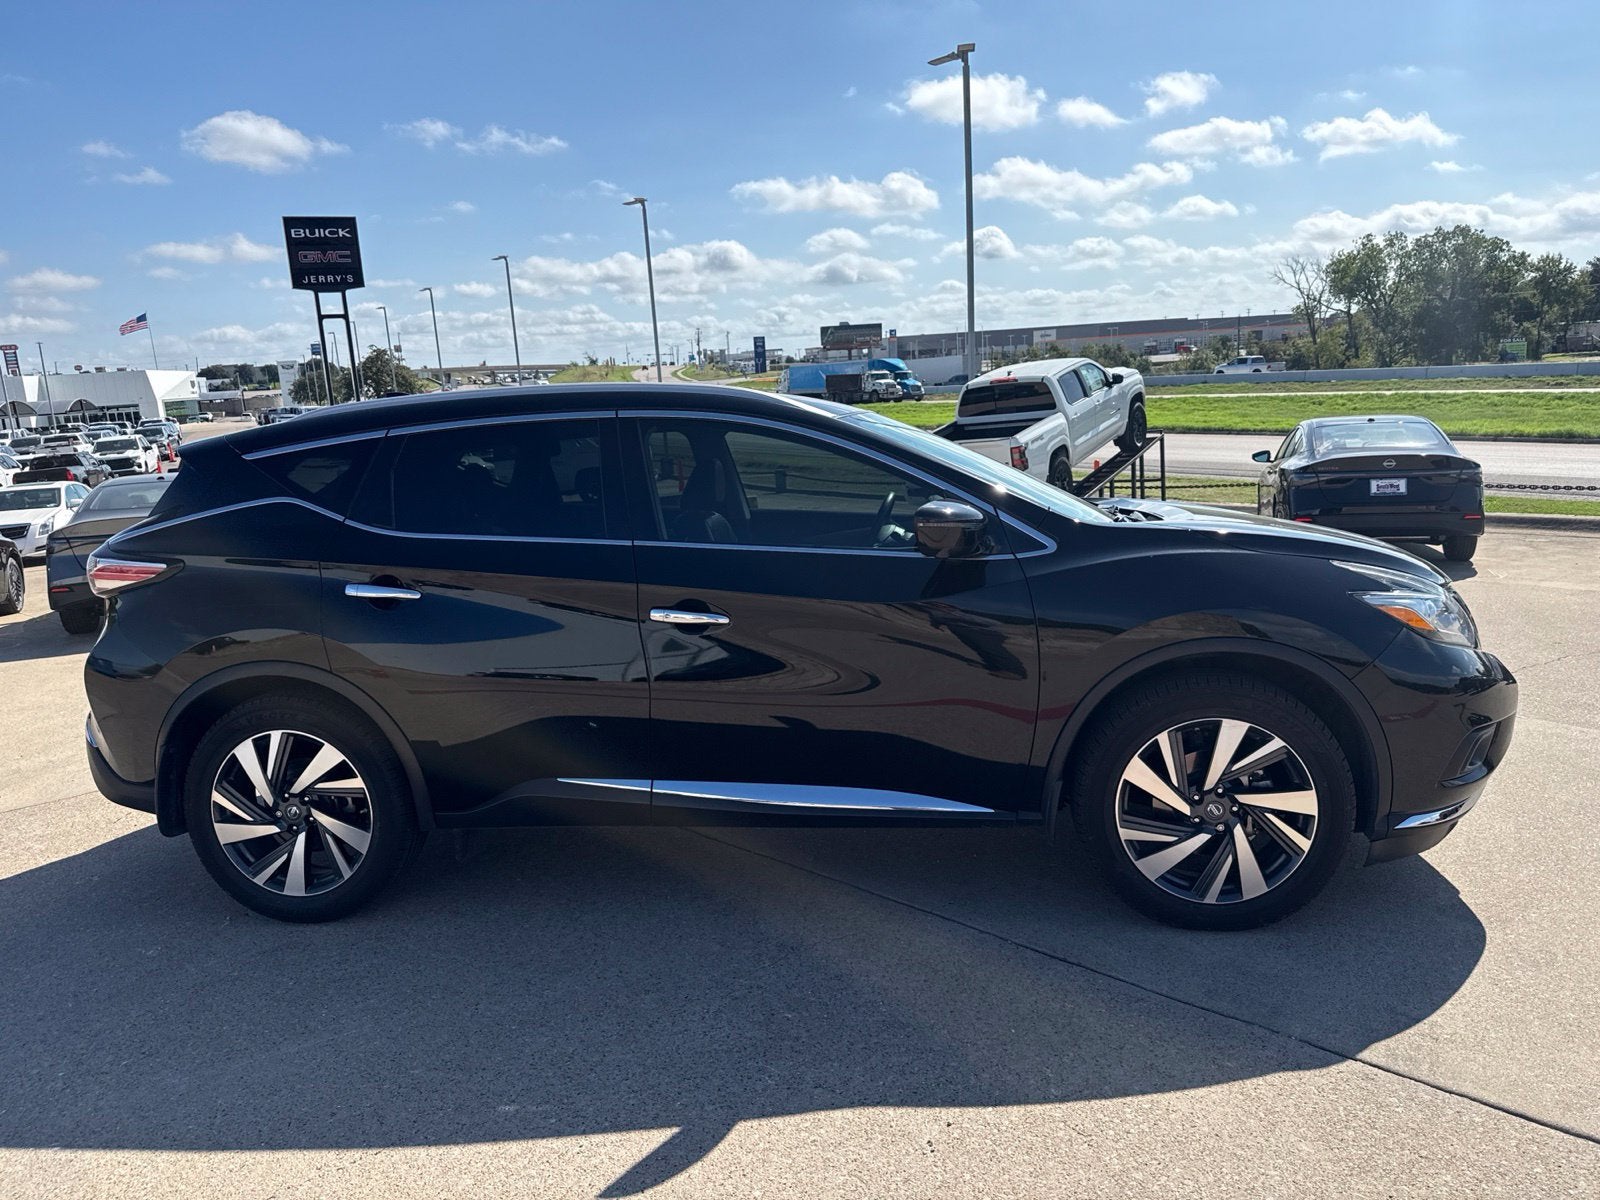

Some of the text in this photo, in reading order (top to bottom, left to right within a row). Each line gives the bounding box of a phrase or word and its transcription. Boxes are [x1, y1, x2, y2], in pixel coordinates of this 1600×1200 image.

[290, 228, 352, 238] BUICK
[298, 251, 352, 263] GMC
[302, 275, 354, 284] JERRY'S
